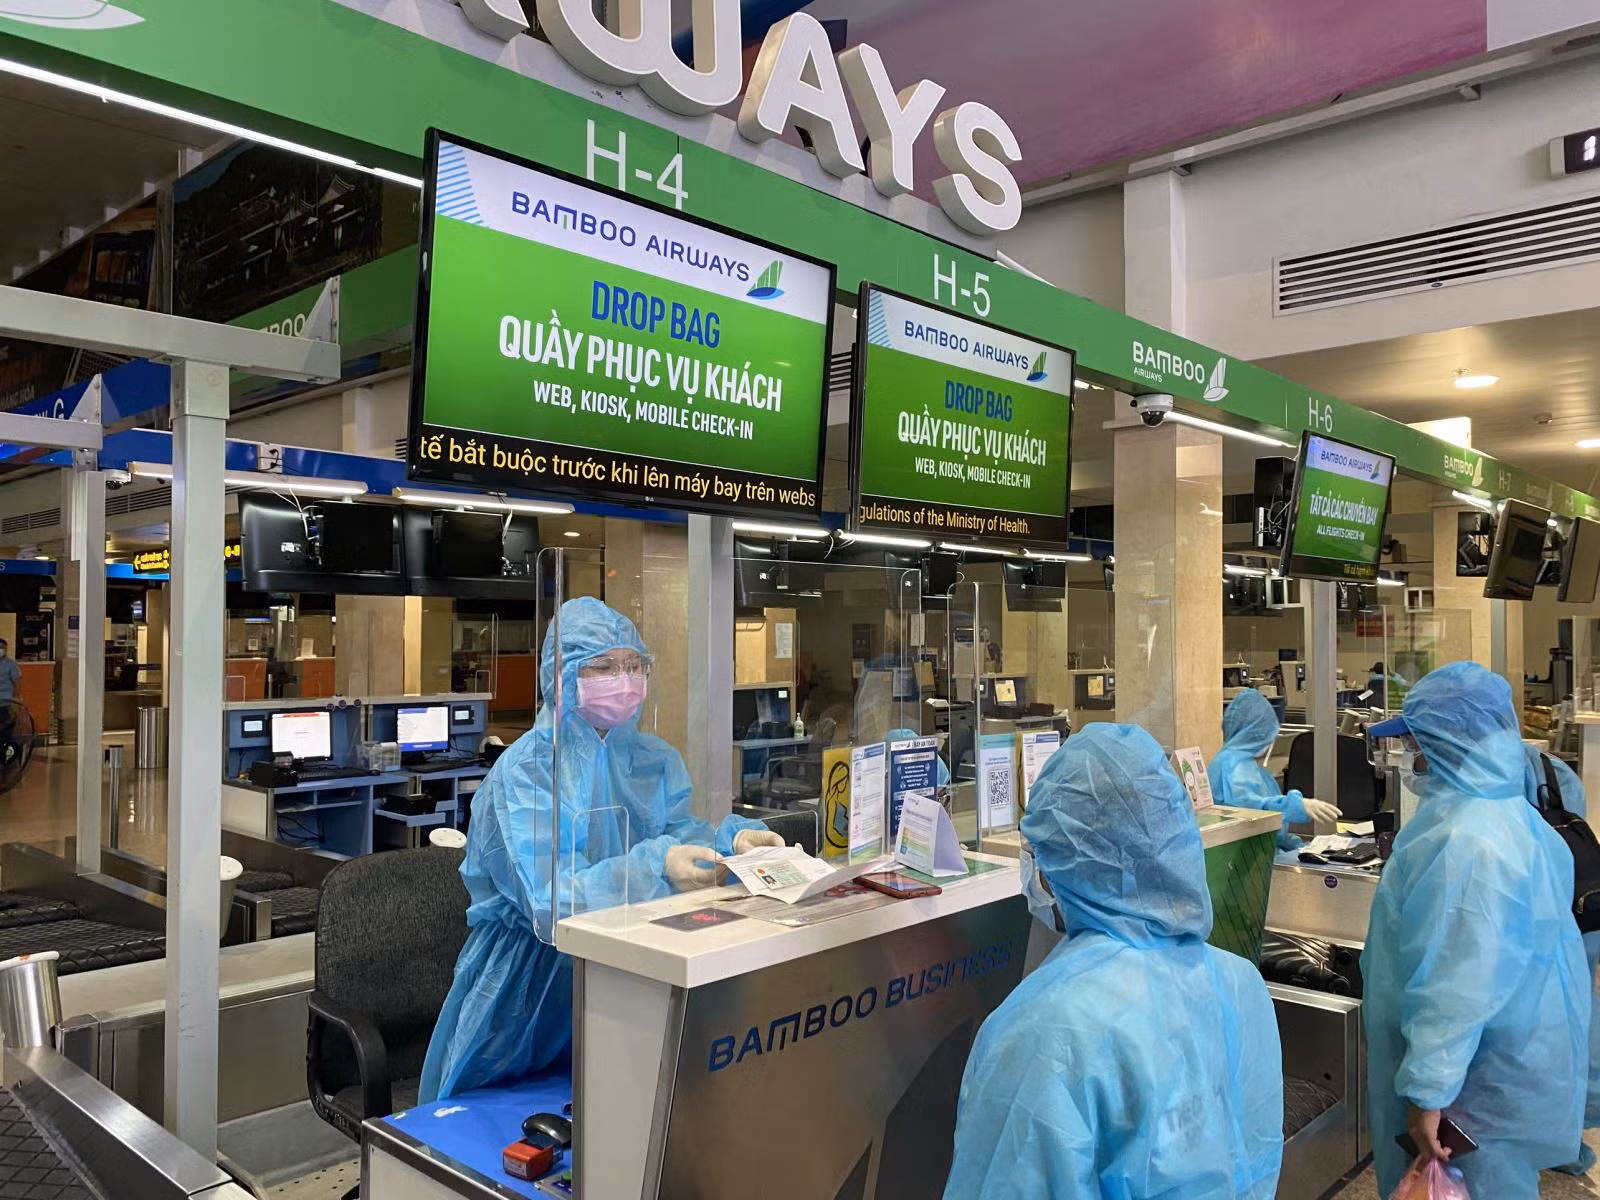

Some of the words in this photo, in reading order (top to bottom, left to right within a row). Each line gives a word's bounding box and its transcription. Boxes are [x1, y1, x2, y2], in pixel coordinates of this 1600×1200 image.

[586, 119, 689, 210] H-4
[511, 191, 636, 247] BAMBOO
[645, 234, 750, 282] AIRWAYS
[591, 280, 665, 333] DROP
[670, 301, 720, 348] BAG
[933, 253, 991, 318] H-5
[499, 308, 584, 370] QUẦY
[587, 335, 661, 393] PHỤC
[666, 352, 700, 404] VỤ
[705, 361, 783, 412] KHÁCH
[904, 320, 969, 353] BAMBOO
[973, 341, 1029, 370] AIRWAYS
[1132, 340, 1205, 385] BAMBOO
[1133, 366, 1163, 383] AIRWAYS
[534, 380, 576, 414] WEB,
[580, 389, 632, 424] KIOSK,
[635, 401, 688, 429] MOBILE
[691, 410, 754, 440] CHECK-IN
[944, 380, 983, 415] DROP
[985, 390, 1013, 422] BAG
[1308, 396, 1333, 433] H-6
[898, 404, 941, 448] QUẦY
[942, 420, 981, 460] PHỤC
[983, 428, 1001, 465] VỤ
[1004, 429, 1047, 466] KHÁCH
[420, 434, 445, 460] tế
[449, 438, 487, 466] bắt
[493, 444, 547, 476] buộc
[552, 455, 606, 481] trước
[611, 460, 638, 485] khi
[643, 465, 669, 489] lên
[674, 473, 710, 499] máy
[714, 475, 742, 502] bay
[745, 481, 775, 502] trên
[779, 486, 816, 507] webs
[915, 456, 938, 479] WEB,
[938, 459, 965, 483] KIOSK,
[967, 465, 996, 484] MOBILE
[996, 469, 1031, 489] CHECK-IN
[1443, 455, 1474, 477] BAMBOO
[913, 508, 926, 525] of
[927, 508, 944, 526] the
[946, 511, 986, 534] Ministry
[987, 515, 998, 531] of
[999, 516, 1031, 534] Health.
[708, 986, 878, 1073] BAMBOO
[885, 940, 1013, 1009] BUSINESS
